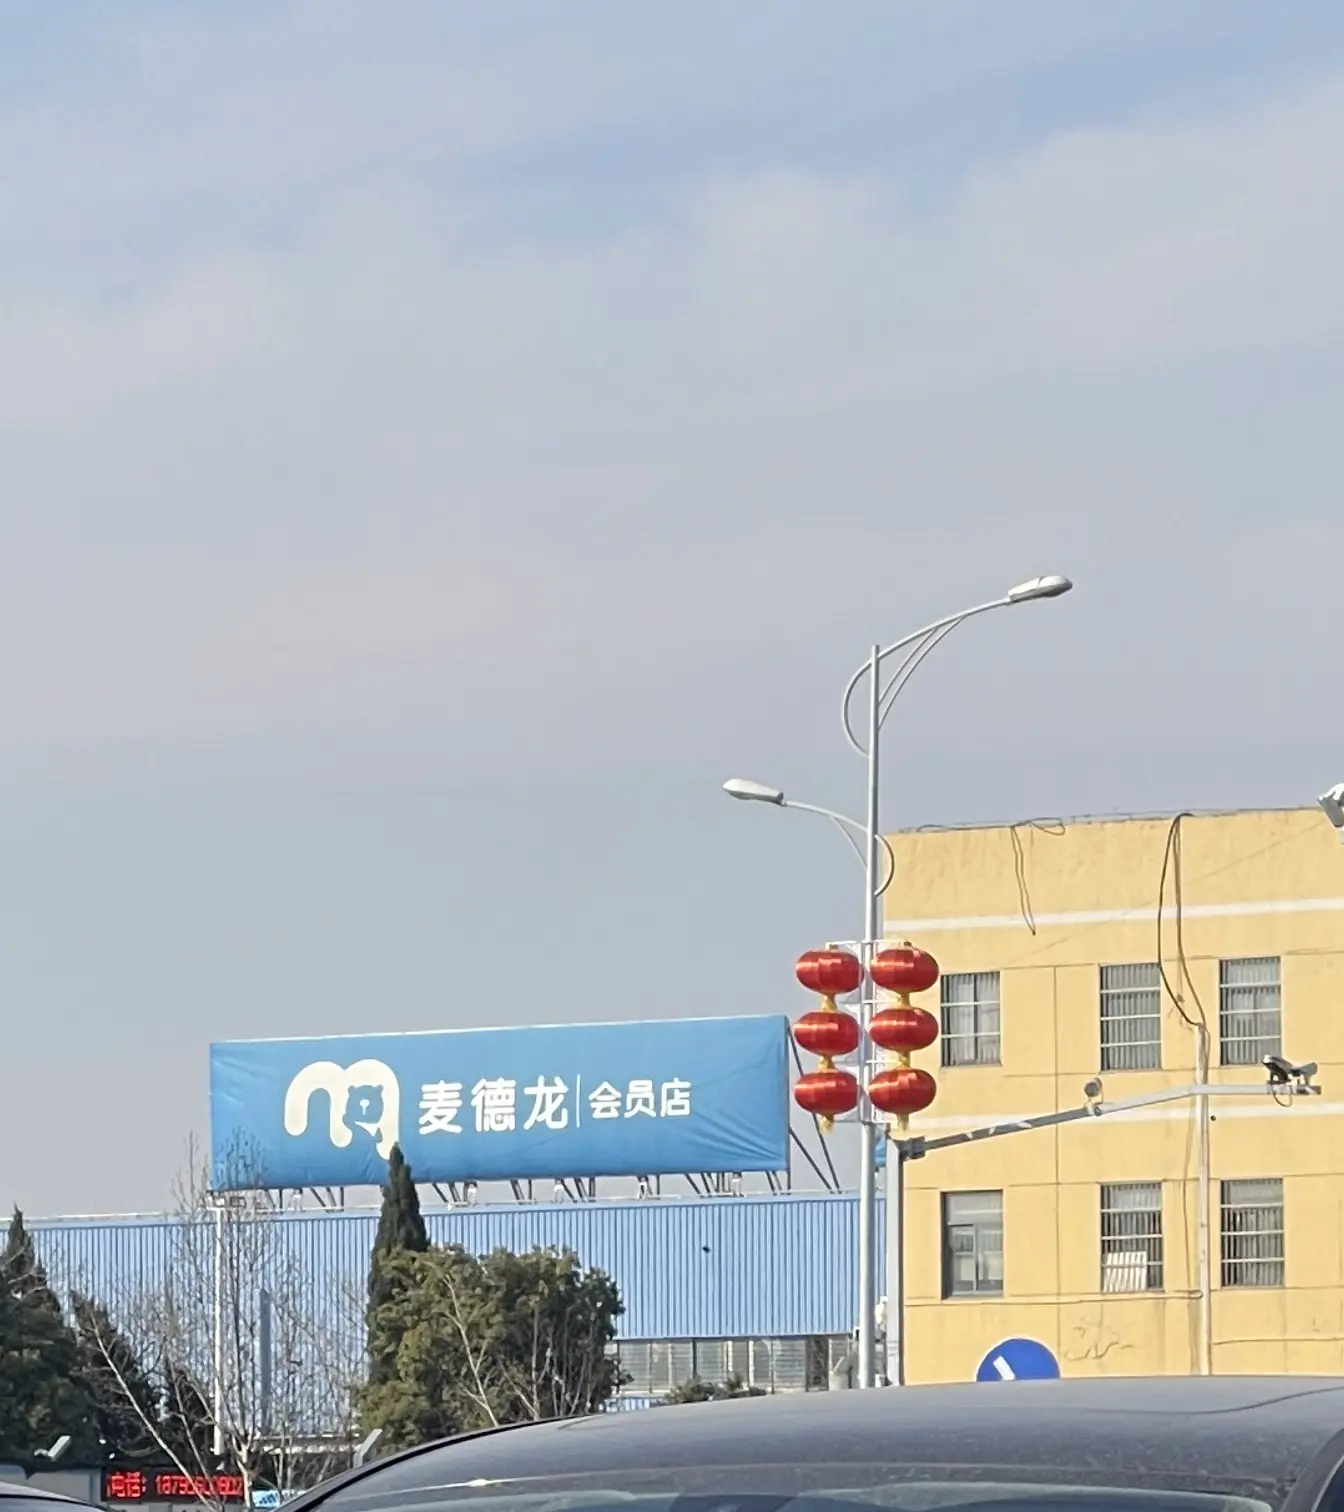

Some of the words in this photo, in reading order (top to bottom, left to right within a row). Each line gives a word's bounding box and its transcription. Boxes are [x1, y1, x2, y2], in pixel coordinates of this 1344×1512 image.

[419, 1075, 570, 1135] 麦德龙
[588, 1078, 692, 1118] 会员店
